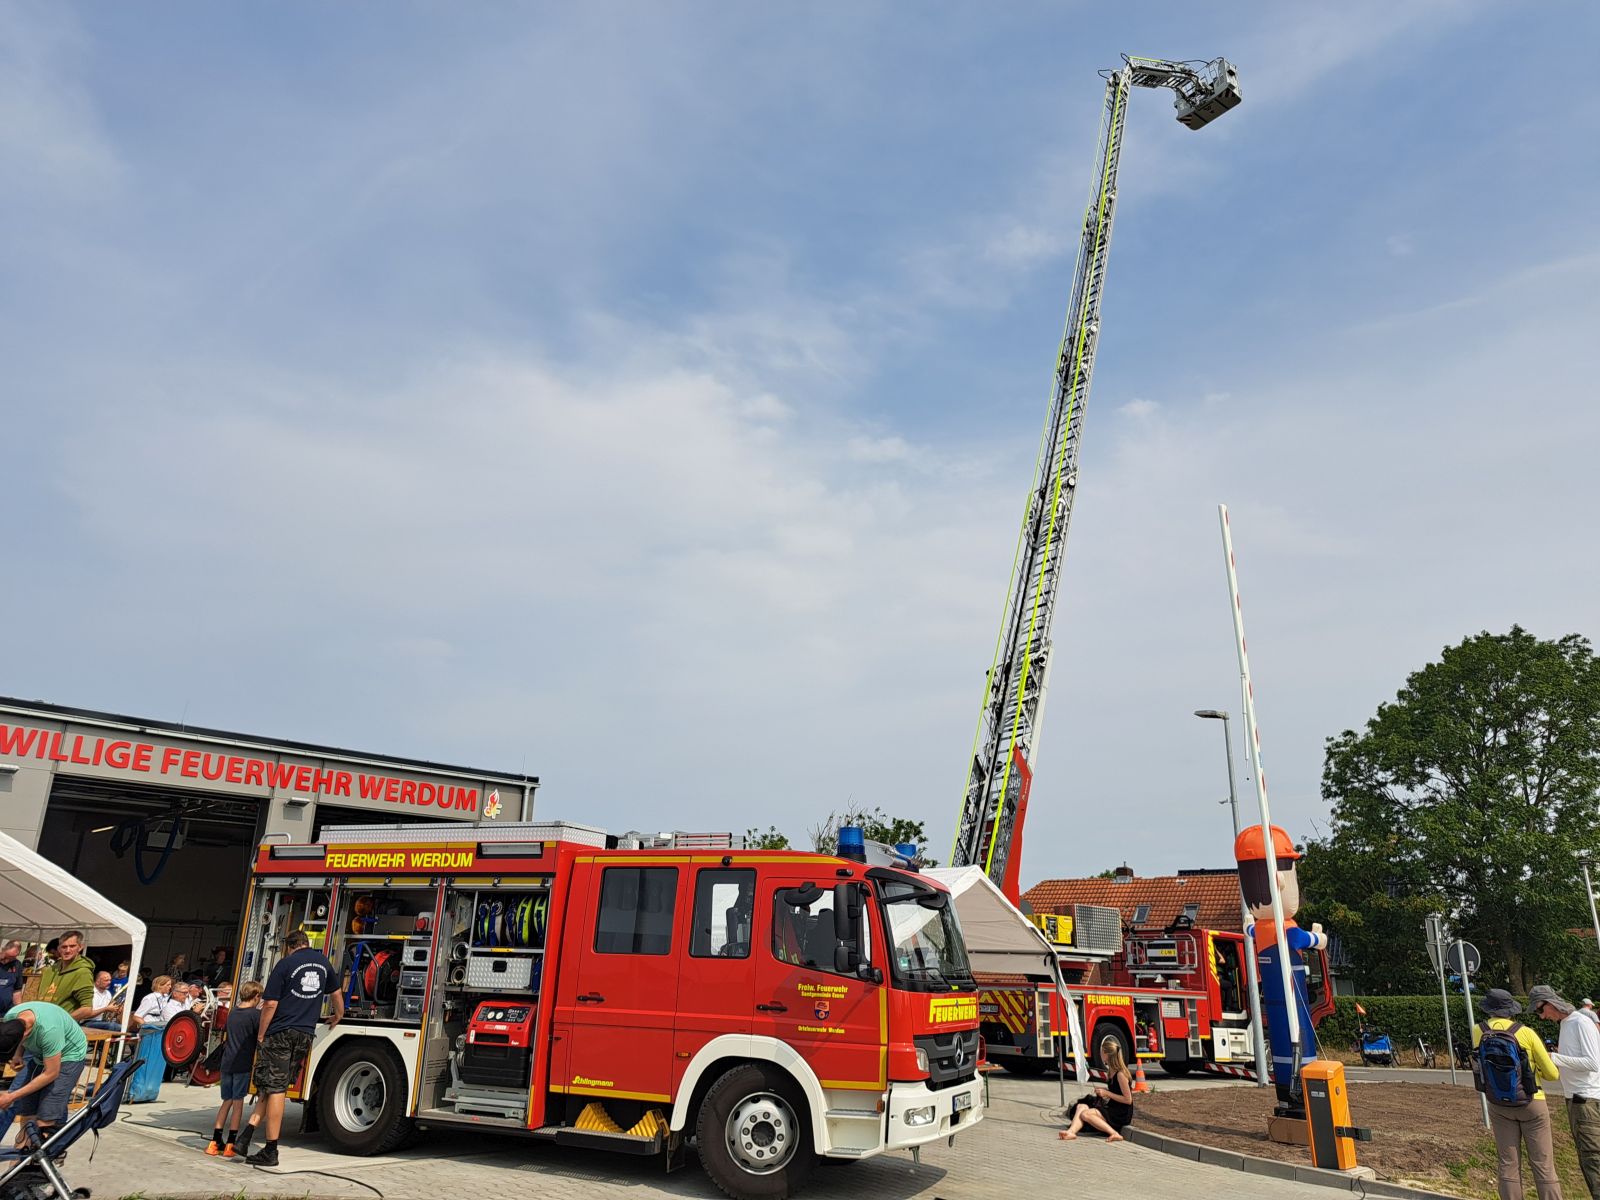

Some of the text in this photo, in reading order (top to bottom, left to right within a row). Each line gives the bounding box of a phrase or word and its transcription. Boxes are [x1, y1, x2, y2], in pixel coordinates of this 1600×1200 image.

[0, 725, 478, 813] WILLIGE FEUERWEHR WERDUM
[325, 851, 474, 869] FEUERWEHR WERDUM
[816, 984, 848, 993] Feuerwehr
[1087, 995, 1130, 1006] FEUERWEHR
[929, 997, 977, 1023] FEUERWEHR
[572, 1076, 614, 1087] Schlingmann
